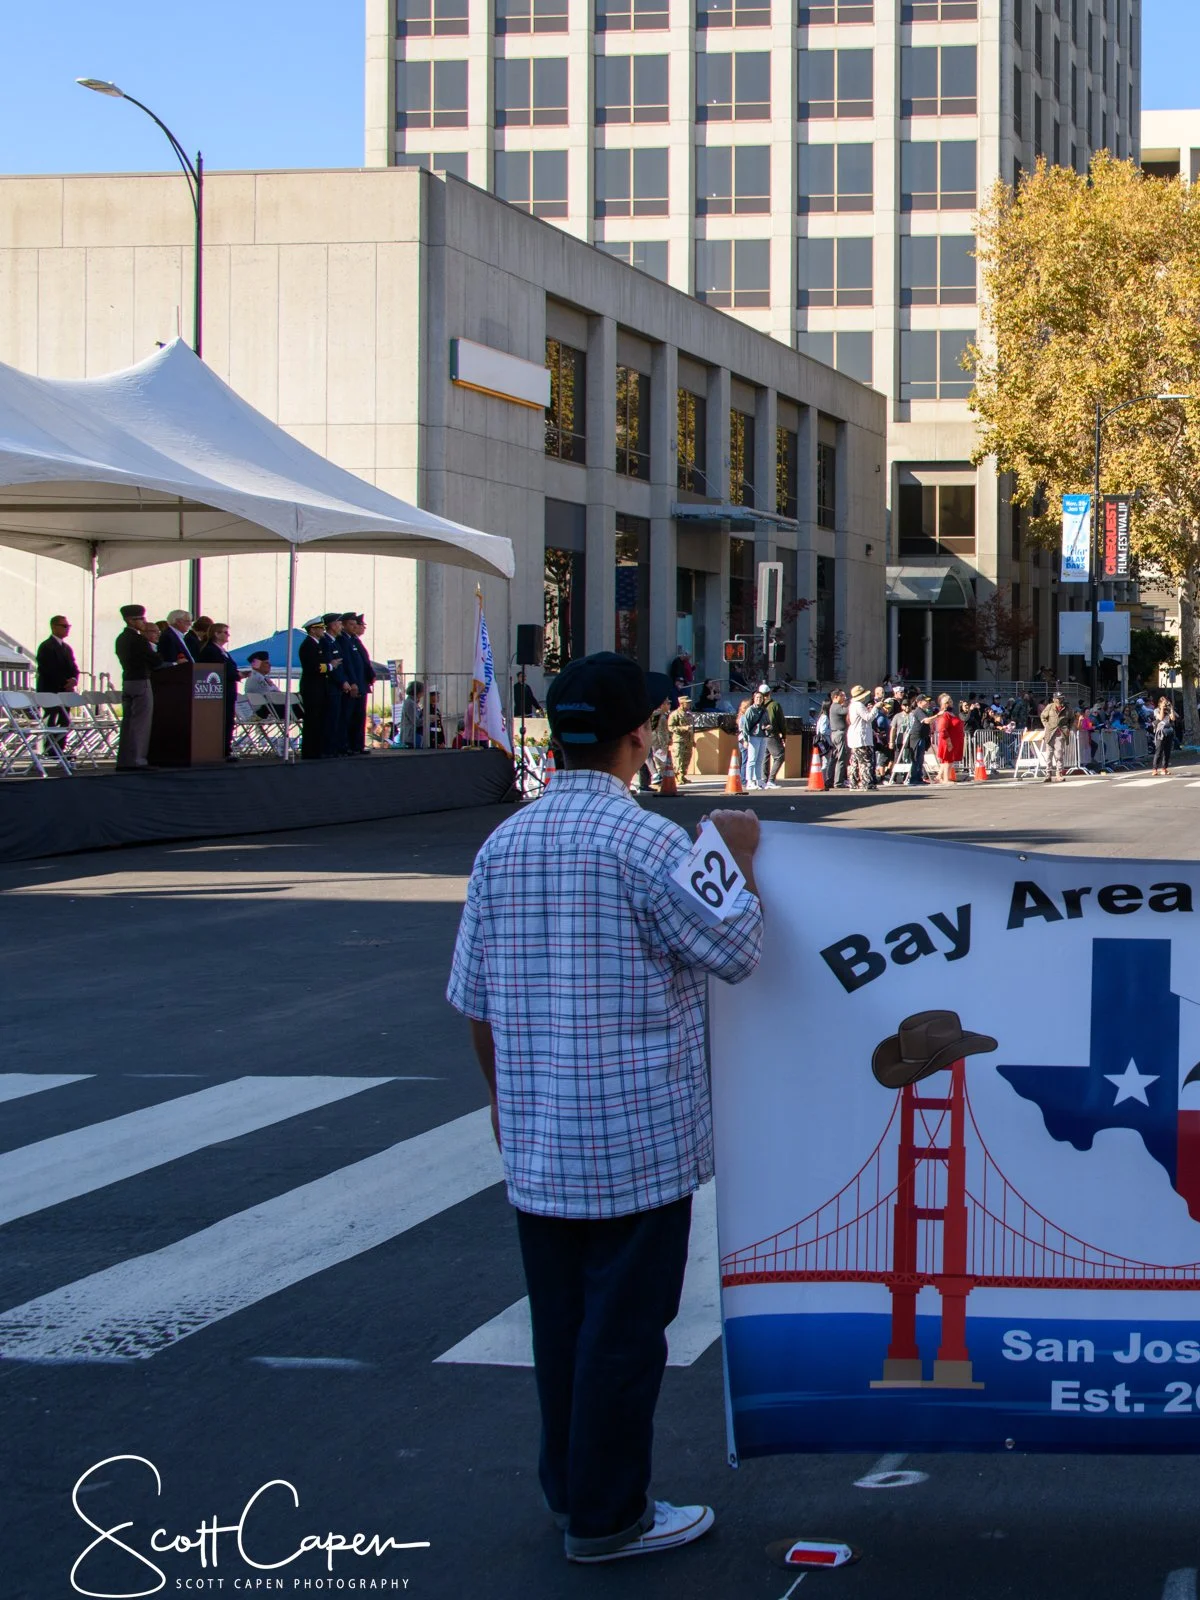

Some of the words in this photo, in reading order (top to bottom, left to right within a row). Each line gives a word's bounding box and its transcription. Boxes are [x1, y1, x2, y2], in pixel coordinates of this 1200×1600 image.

[1105, 502, 1117, 575] CINEQUEST
[1117, 553, 1128, 574] FILM
[194, 684, 208, 693] SAN
[691, 850, 739, 908] 62
[818, 903, 972, 994] Bay
[1006, 880, 1194, 930] Area
[1001, 1329, 1095, 1363] San
[1050, 1380, 1145, 1413] Est.
